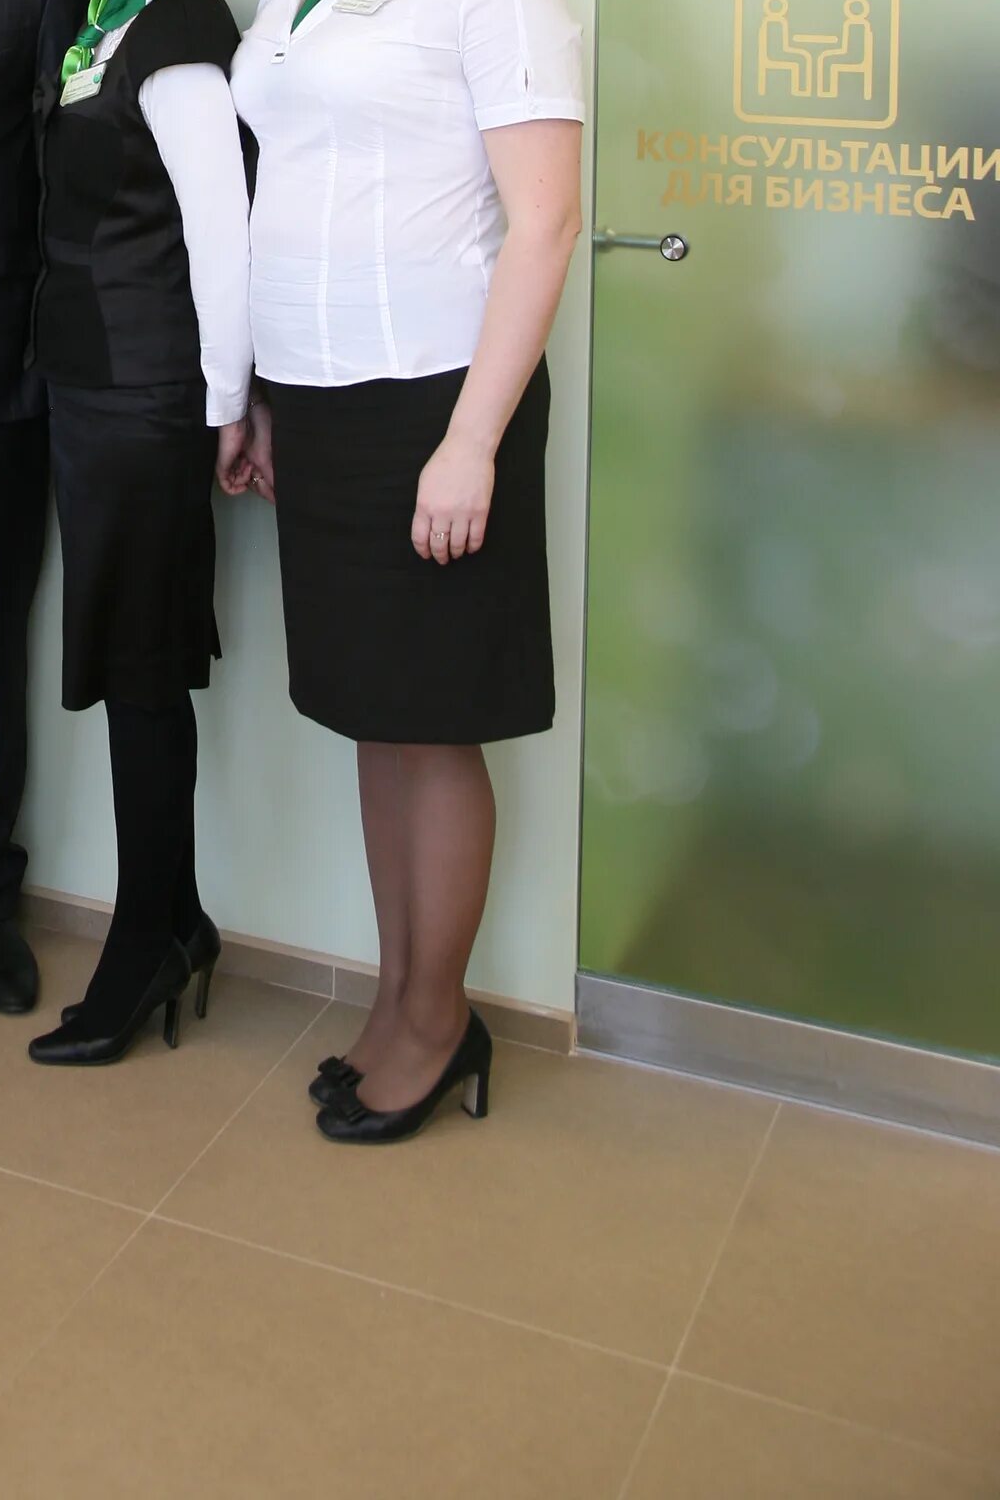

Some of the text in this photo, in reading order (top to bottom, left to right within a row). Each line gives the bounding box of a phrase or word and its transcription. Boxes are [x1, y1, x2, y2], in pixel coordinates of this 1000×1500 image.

[636, 128, 1000, 184] КОНСУЛЬТАЦИИ
[660, 168, 976, 221] ДЛЯ БИЗНЕСА
